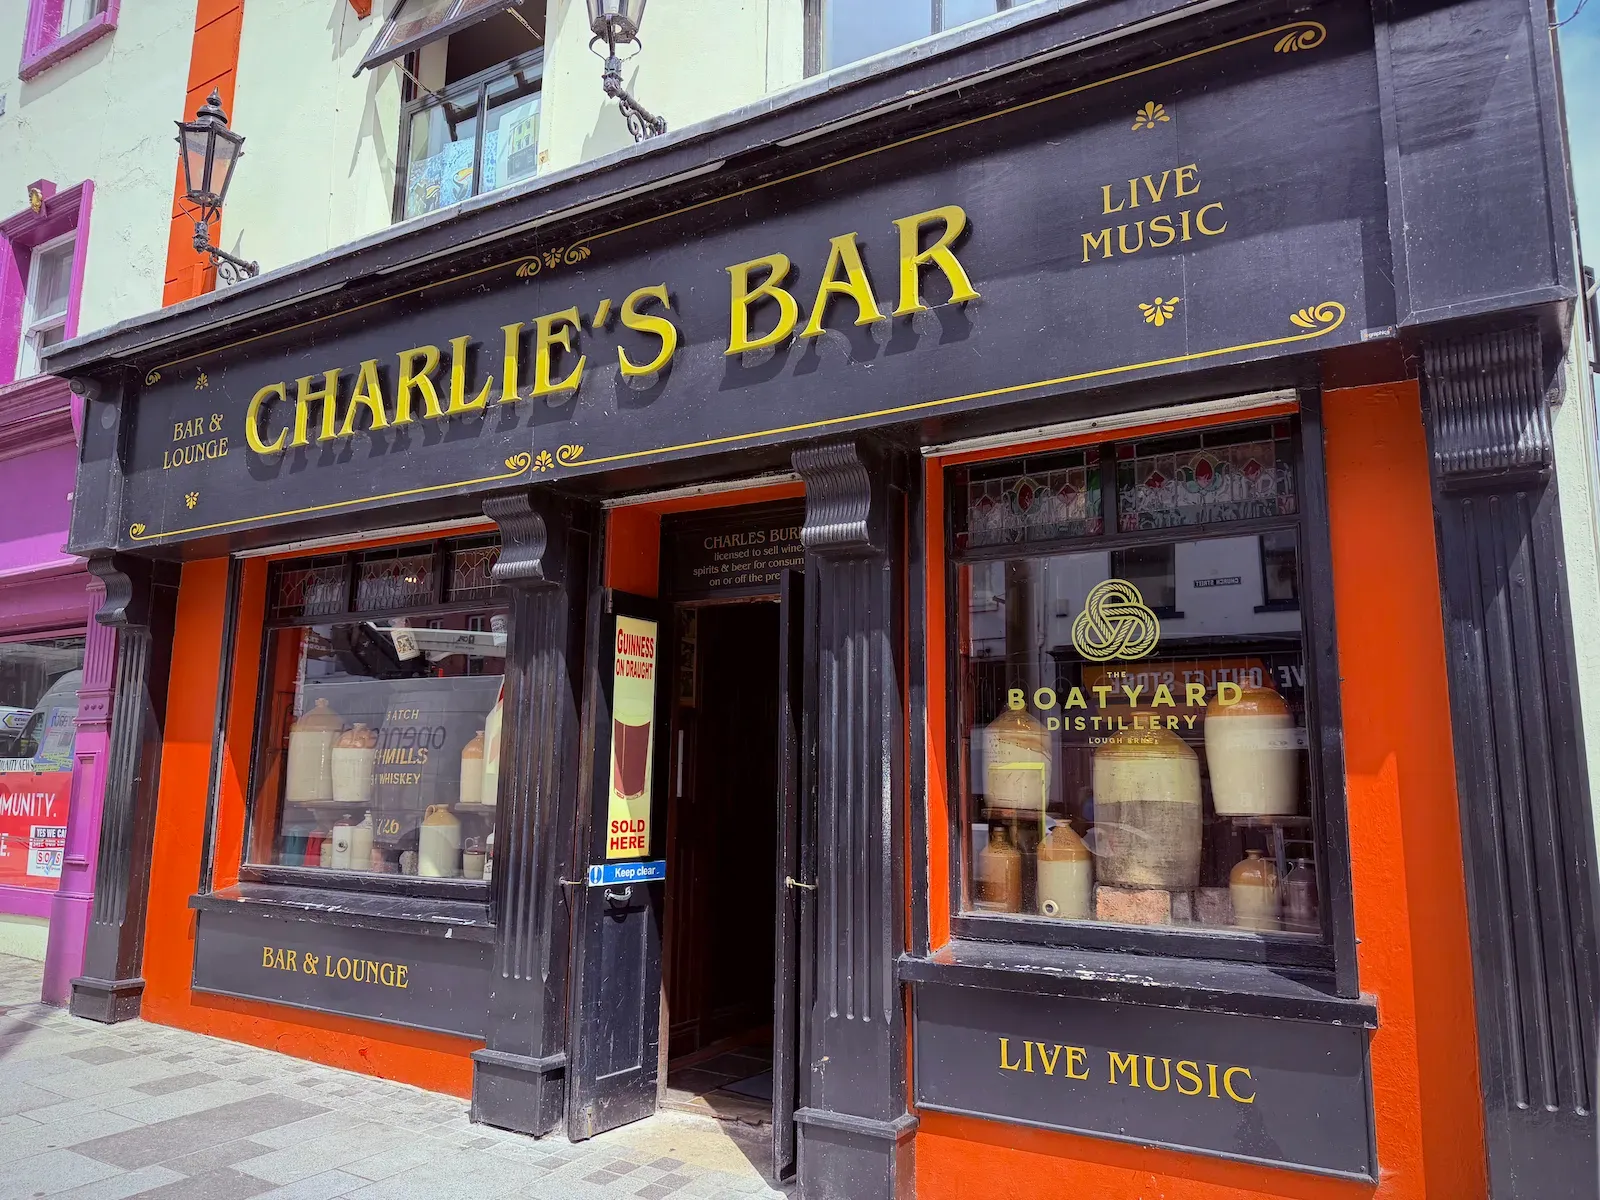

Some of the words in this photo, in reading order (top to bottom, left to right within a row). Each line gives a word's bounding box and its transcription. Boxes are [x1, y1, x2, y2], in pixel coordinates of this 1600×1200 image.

[1101, 163, 1201, 214] LIVE
[1081, 202, 1228, 263] MUSIC
[245, 283, 677, 455] CHARLIE'S
[724, 204, 981, 356] BAR
[173, 418, 204, 442] BAR
[209, 413, 224, 432] &
[163, 437, 229, 470] LOUNGE
[704, 531, 765, 549] CHARLES
[714, 549, 750, 561] licensed
[752, 548, 761, 557] to
[763, 546, 778, 556] sell
[693, 566, 719, 577] spirits
[721, 564, 729, 573] &
[731, 561, 751, 572] beer
[754, 560, 766, 570] for
[709, 579, 721, 587] on
[723, 577, 733, 585] or
[735, 575, 747, 584] off
[749, 573, 763, 582] the
[617, 628, 654, 659] GUINNESS
[616, 658, 624, 677] ON
[626, 659, 653, 680] DRAUGHT
[1107, 671, 1127, 679] THE
[1008, 681, 1243, 710] BOATYARD
[1047, 715, 1197, 731] DISTILLERY
[380, 773, 421, 785] WHISKEY
[0, 793, 56, 817] MUNITY.
[611, 819, 645, 834] SOLD
[610, 836, 645, 850] HERE
[615, 867, 635, 879] Keep
[262, 946, 297, 972] BAR
[303, 952, 319, 975] &
[325, 955, 409, 989] LOUNGE
[999, 1037, 1090, 1080] LIVE
[1107, 1051, 1256, 1104] MUSIC
